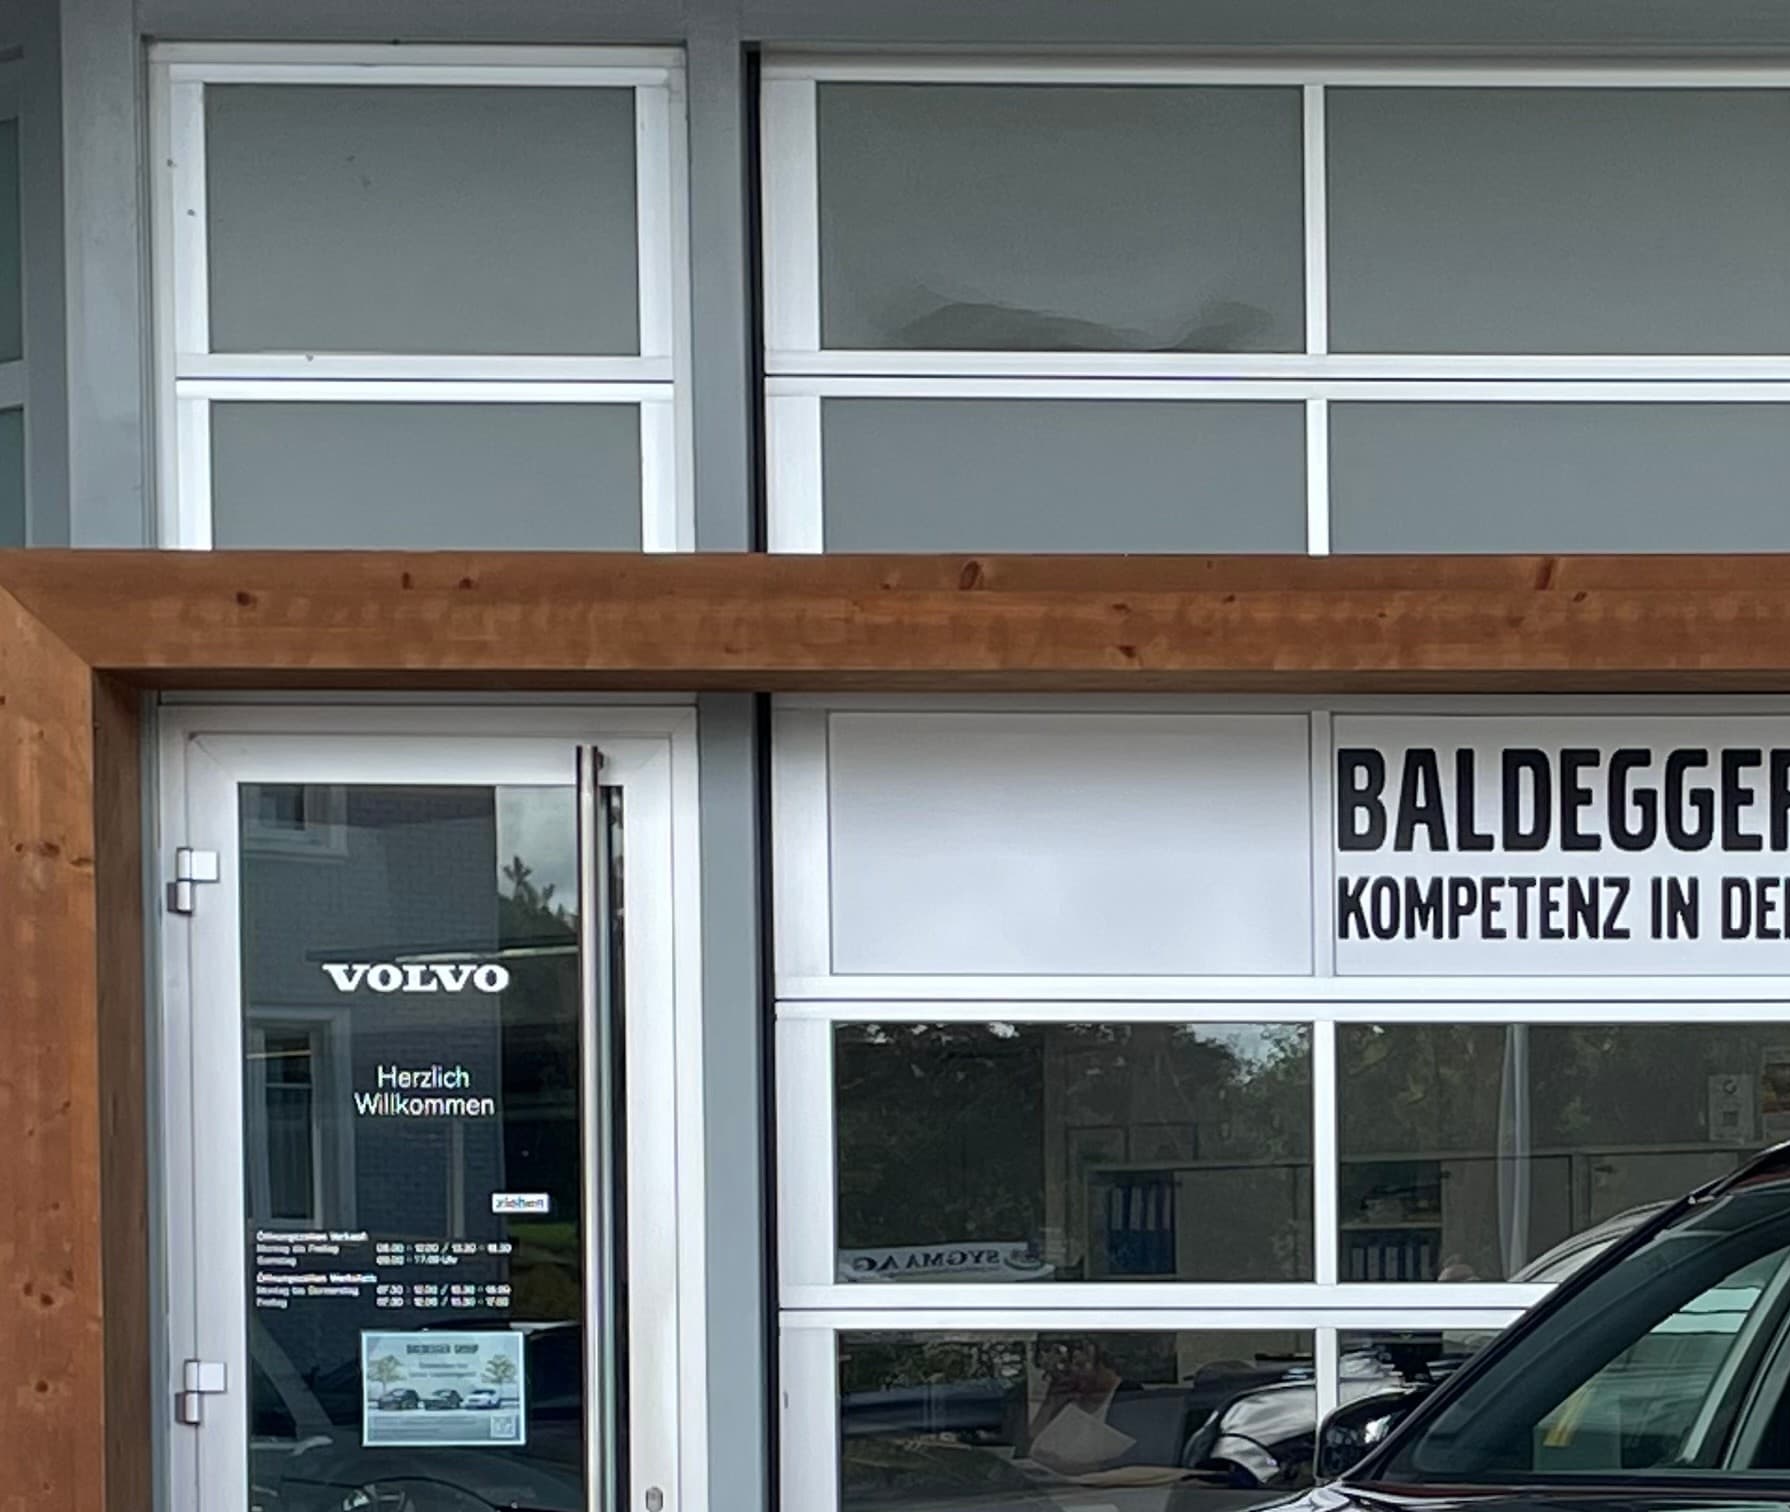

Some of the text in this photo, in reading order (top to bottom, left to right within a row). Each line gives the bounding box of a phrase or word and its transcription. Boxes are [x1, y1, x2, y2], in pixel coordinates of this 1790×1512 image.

[1338, 876, 1630, 940] KOMPETENZ
[1651, 876, 1699, 940] IN
[322, 963, 510, 993] VOLVO
[377, 1065, 470, 1089] Herzlich
[354, 1092, 495, 1116] Willkommen
